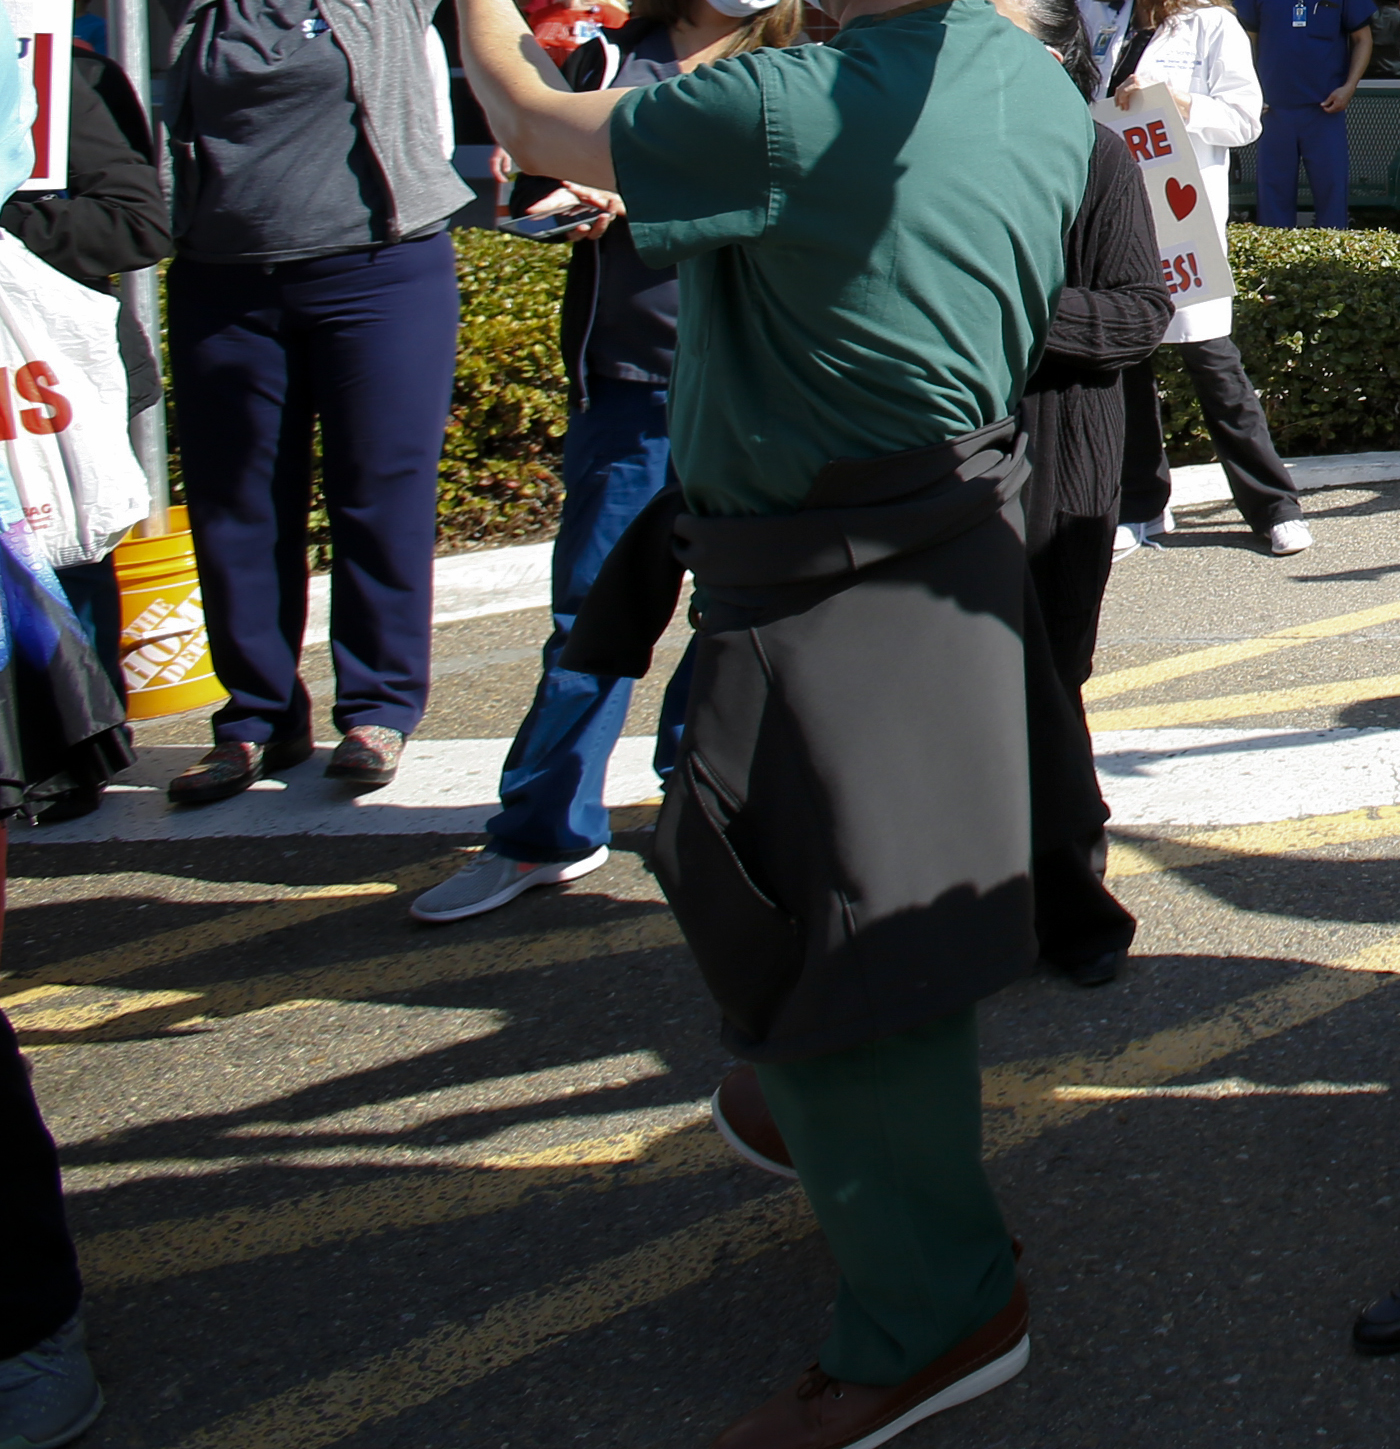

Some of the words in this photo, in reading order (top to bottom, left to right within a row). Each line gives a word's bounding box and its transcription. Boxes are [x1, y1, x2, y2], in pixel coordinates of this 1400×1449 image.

[1122, 120, 1172, 163] RE
[1161, 253, 1202, 294] ES!
[120, 598, 176, 640] THE
